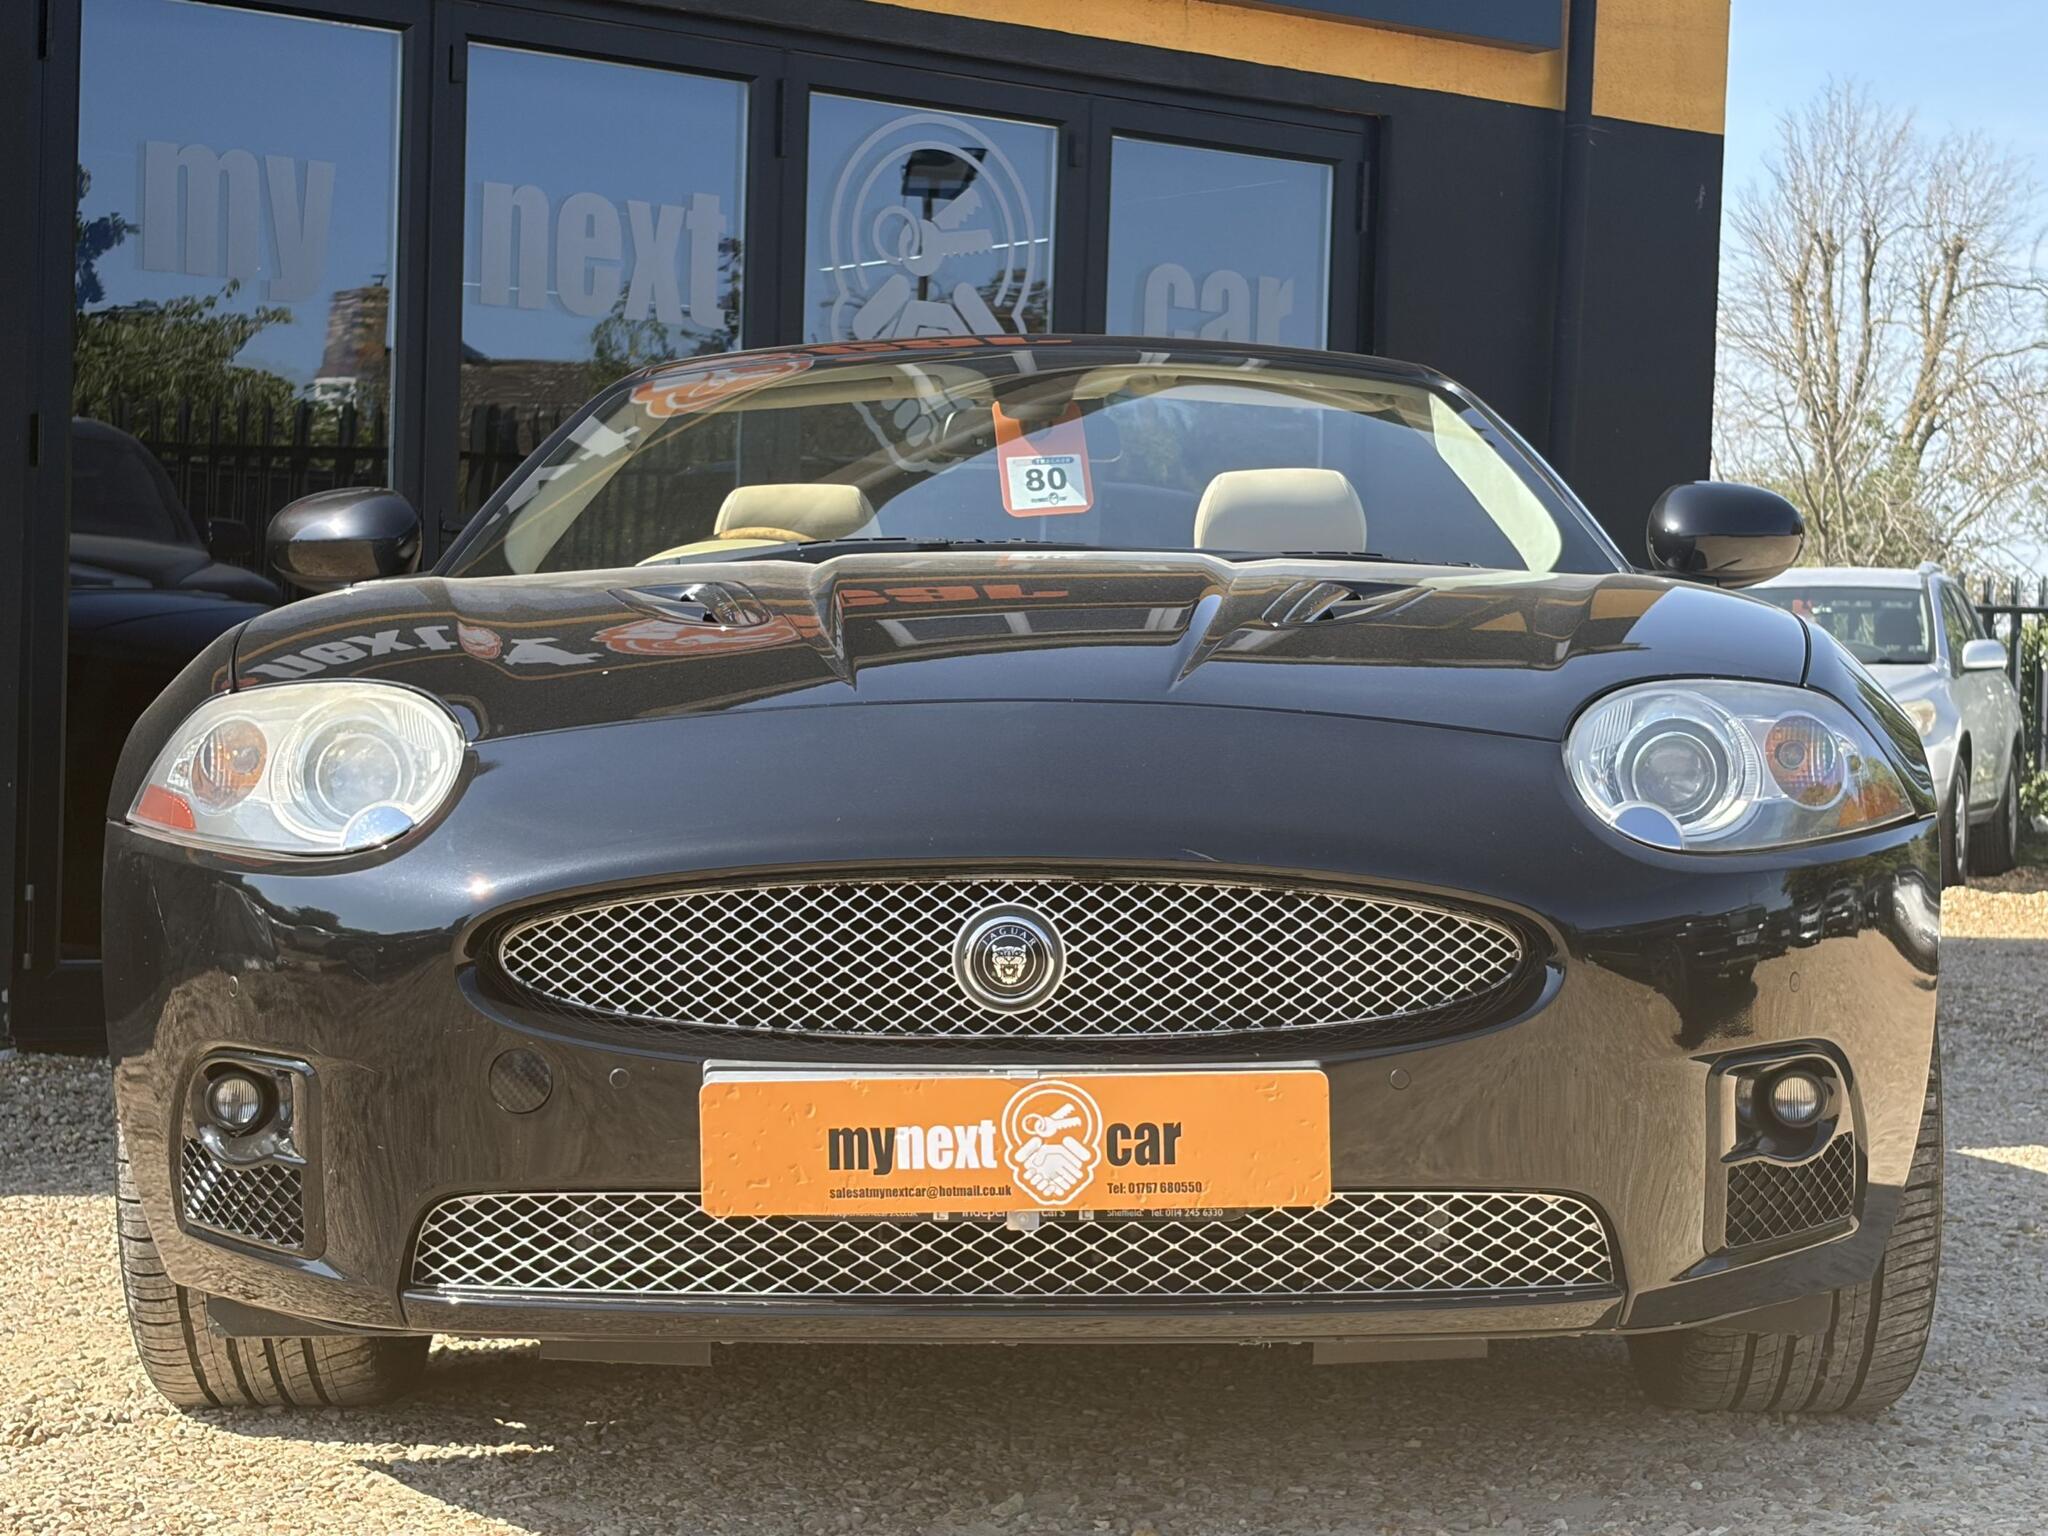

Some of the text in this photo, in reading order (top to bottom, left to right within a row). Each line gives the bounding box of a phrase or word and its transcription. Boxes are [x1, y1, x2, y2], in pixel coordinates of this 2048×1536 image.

[143, 140, 1295, 344] my next car
[1026, 467, 1067, 491] 80
[982, 927, 1037, 947] JAGUAR
[828, 1120, 1182, 1175] mynext car
[829, 1185, 1012, 1200] salesatmynextcar@hotmail.co.uk
[1107, 1182, 1203, 1194] Tel: 01767 680550
[1184, 1208, 1200, 1217] 245
[1202, 1207, 1224, 1217] 6330
